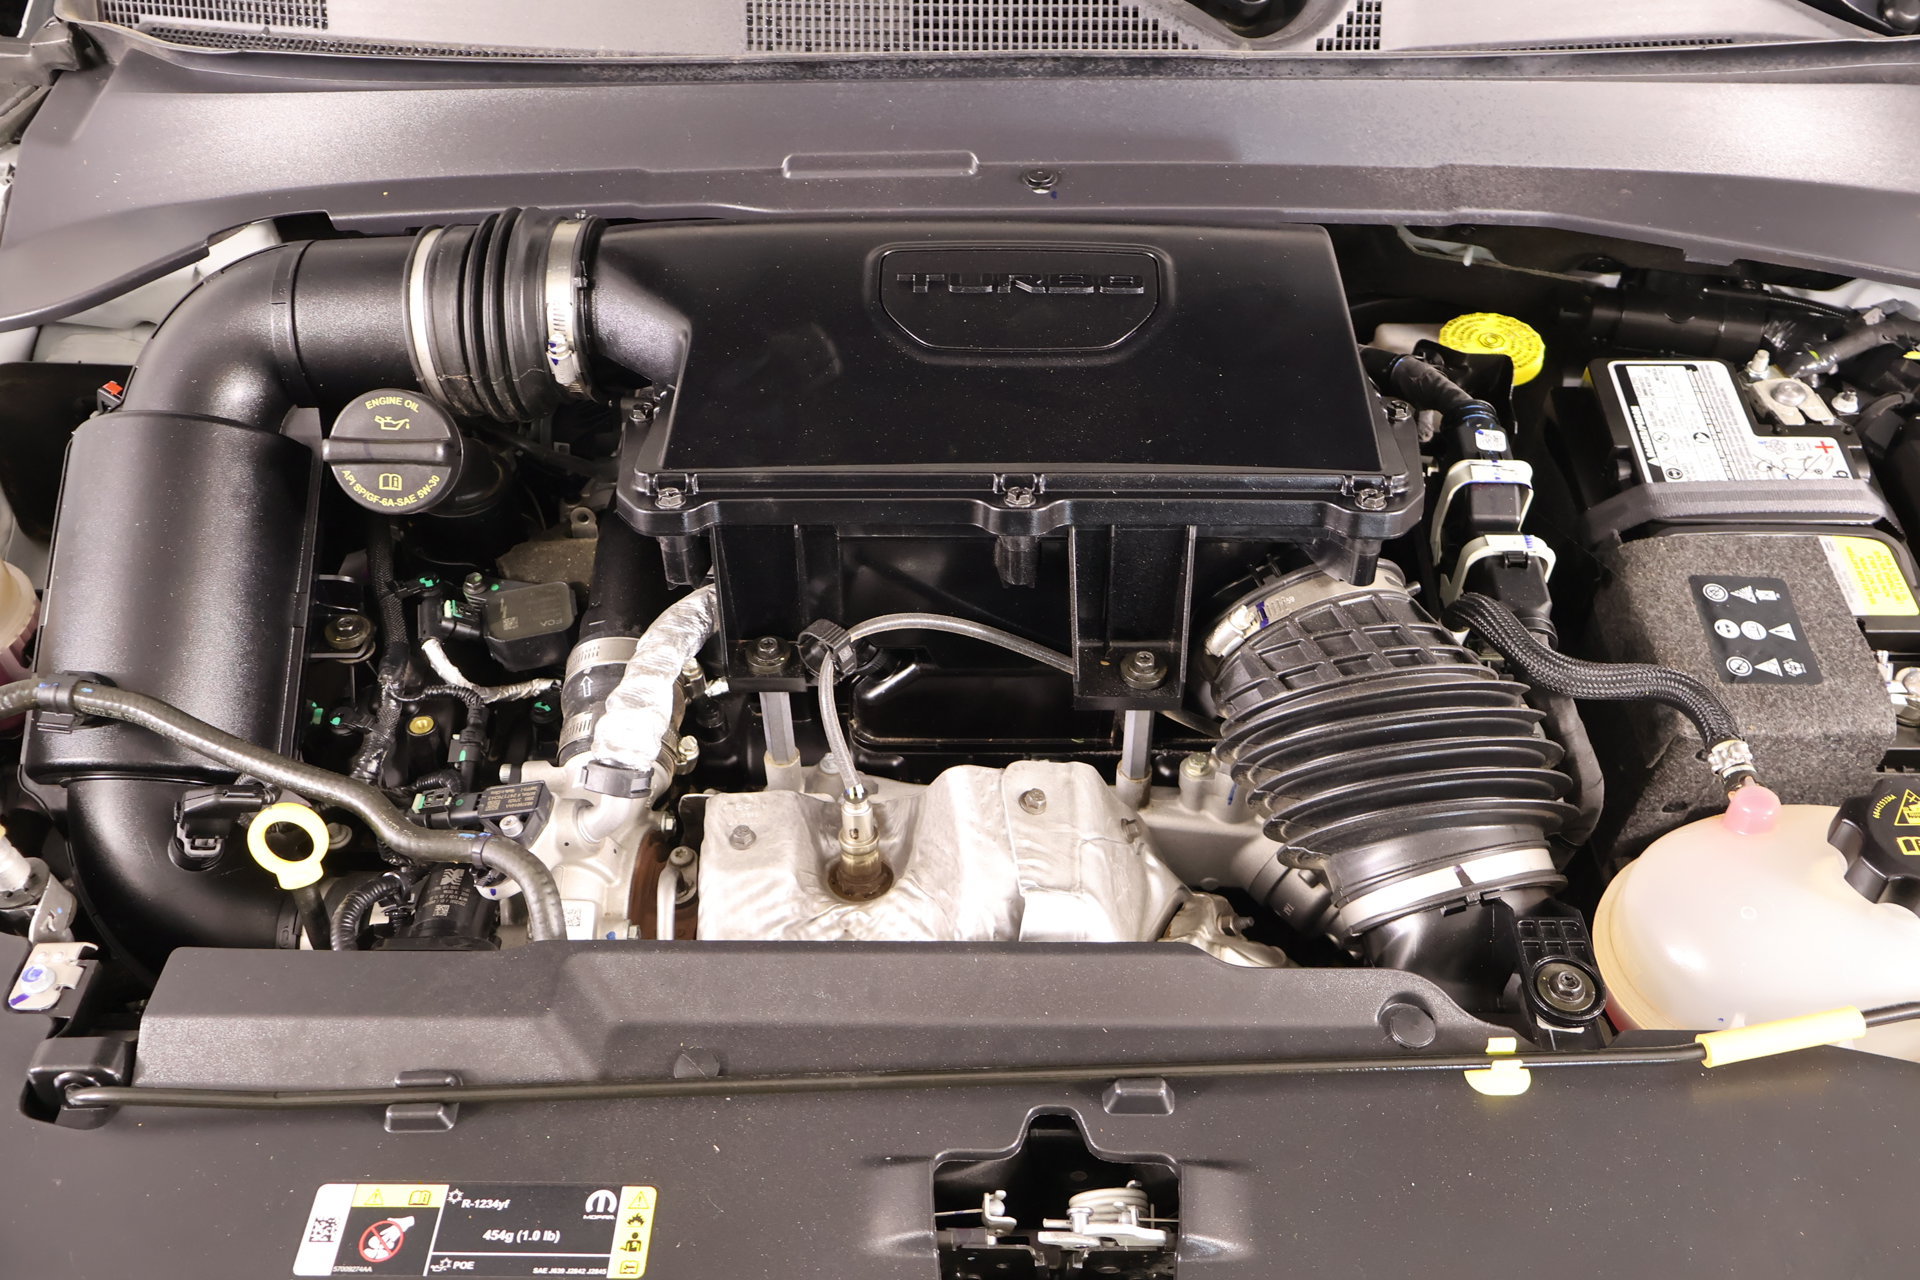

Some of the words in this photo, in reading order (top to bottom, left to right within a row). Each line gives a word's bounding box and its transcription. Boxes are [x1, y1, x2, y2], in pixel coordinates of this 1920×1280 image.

[365, 396, 403, 410] ENGINE
[404, 399, 420, 413] OIL
[341, 470, 357, 486] API
[417, 474, 440, 499] 5W-30
[461, 1198, 511, 1211] R-1234yf
[482, 1229, 514, 1244] 454g
[516, 1229, 541, 1244] (1.0
[542, 1229, 561, 1244] lb)
[452, 1260, 476, 1270] POE
